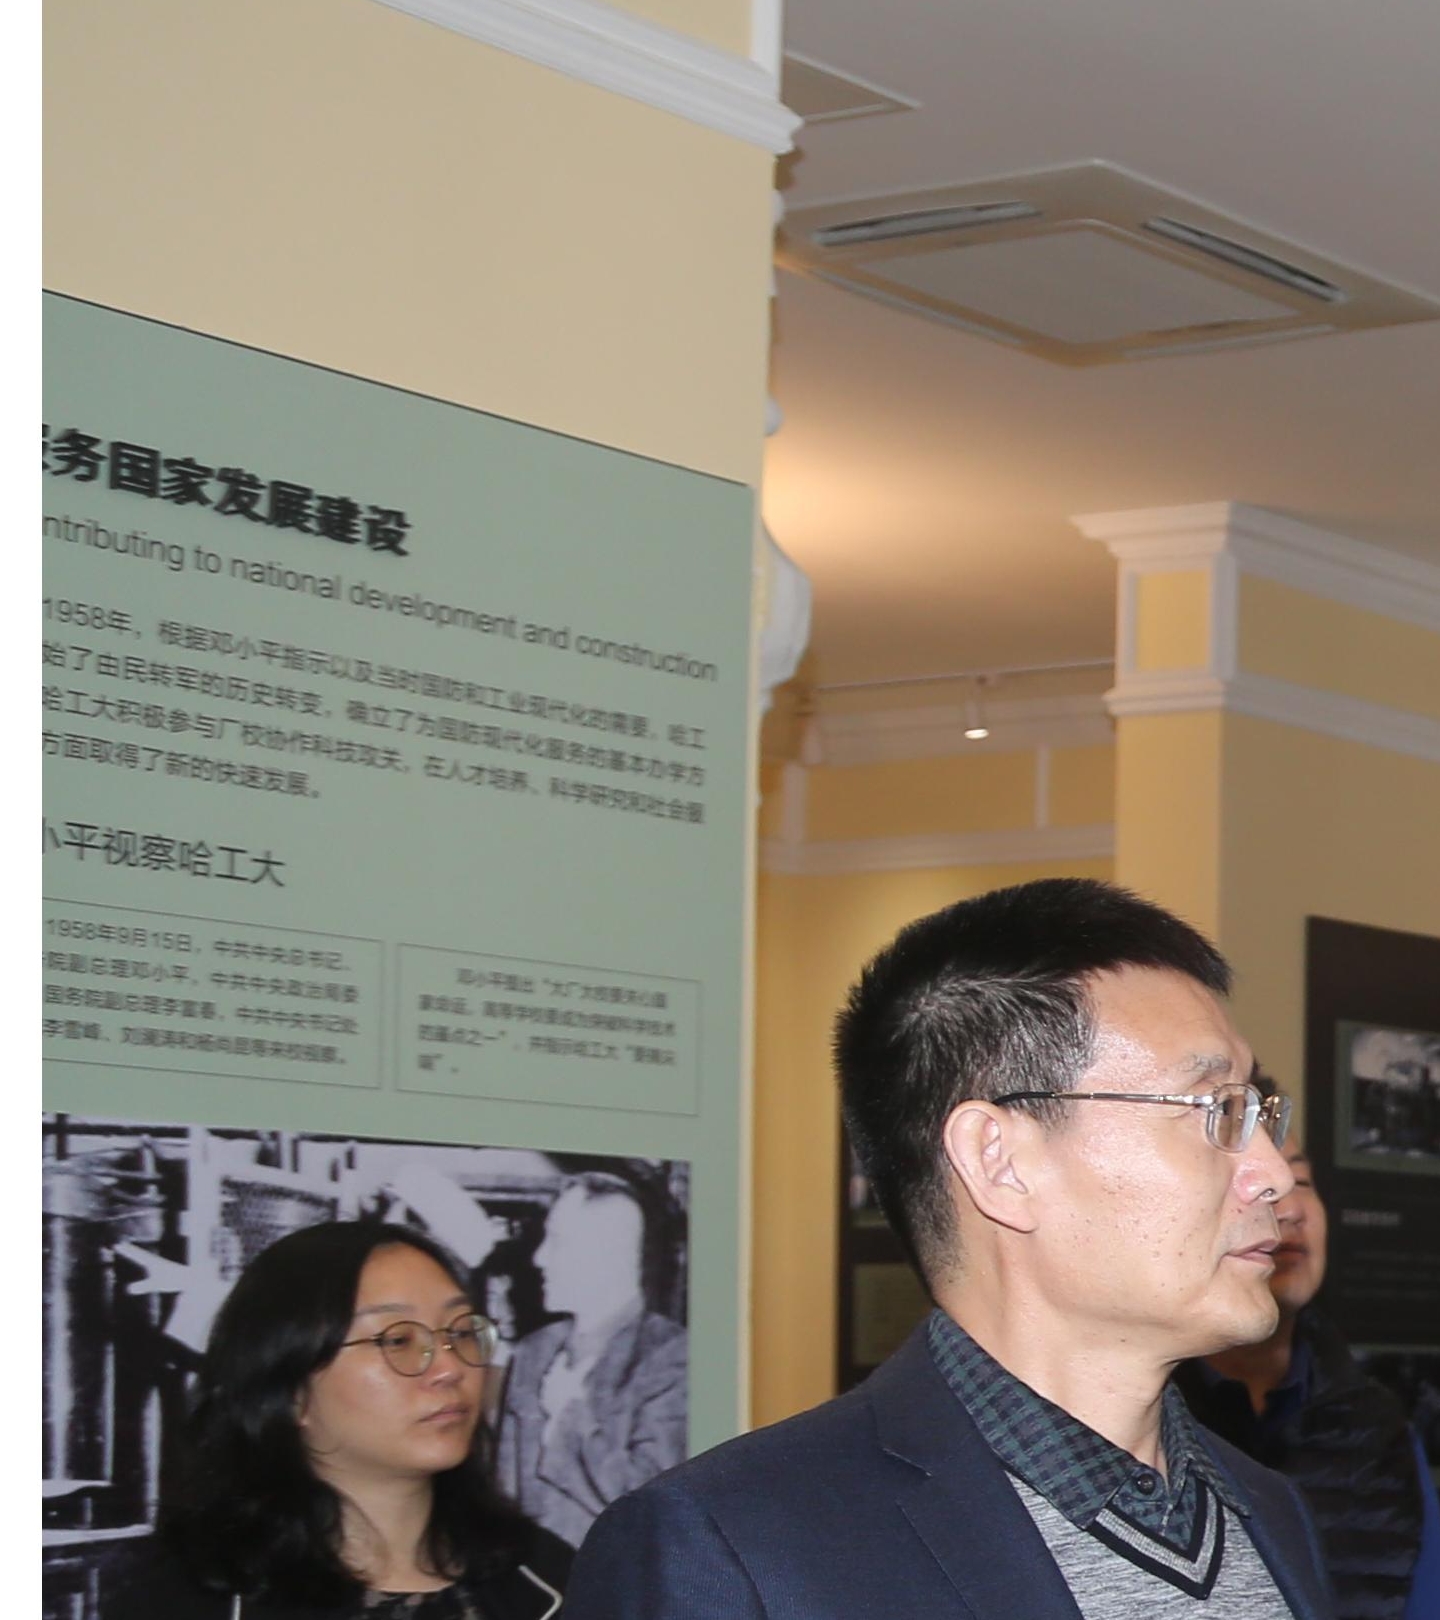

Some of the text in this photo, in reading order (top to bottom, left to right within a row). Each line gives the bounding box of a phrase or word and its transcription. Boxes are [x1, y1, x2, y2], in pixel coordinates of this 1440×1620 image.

[42, 423, 412, 556] 务国家发展建设
[195, 545, 222, 573] to
[230, 554, 341, 599] national
[350, 575, 517, 640] development
[522, 622, 571, 650] and
[575, 633, 717, 682] construction
